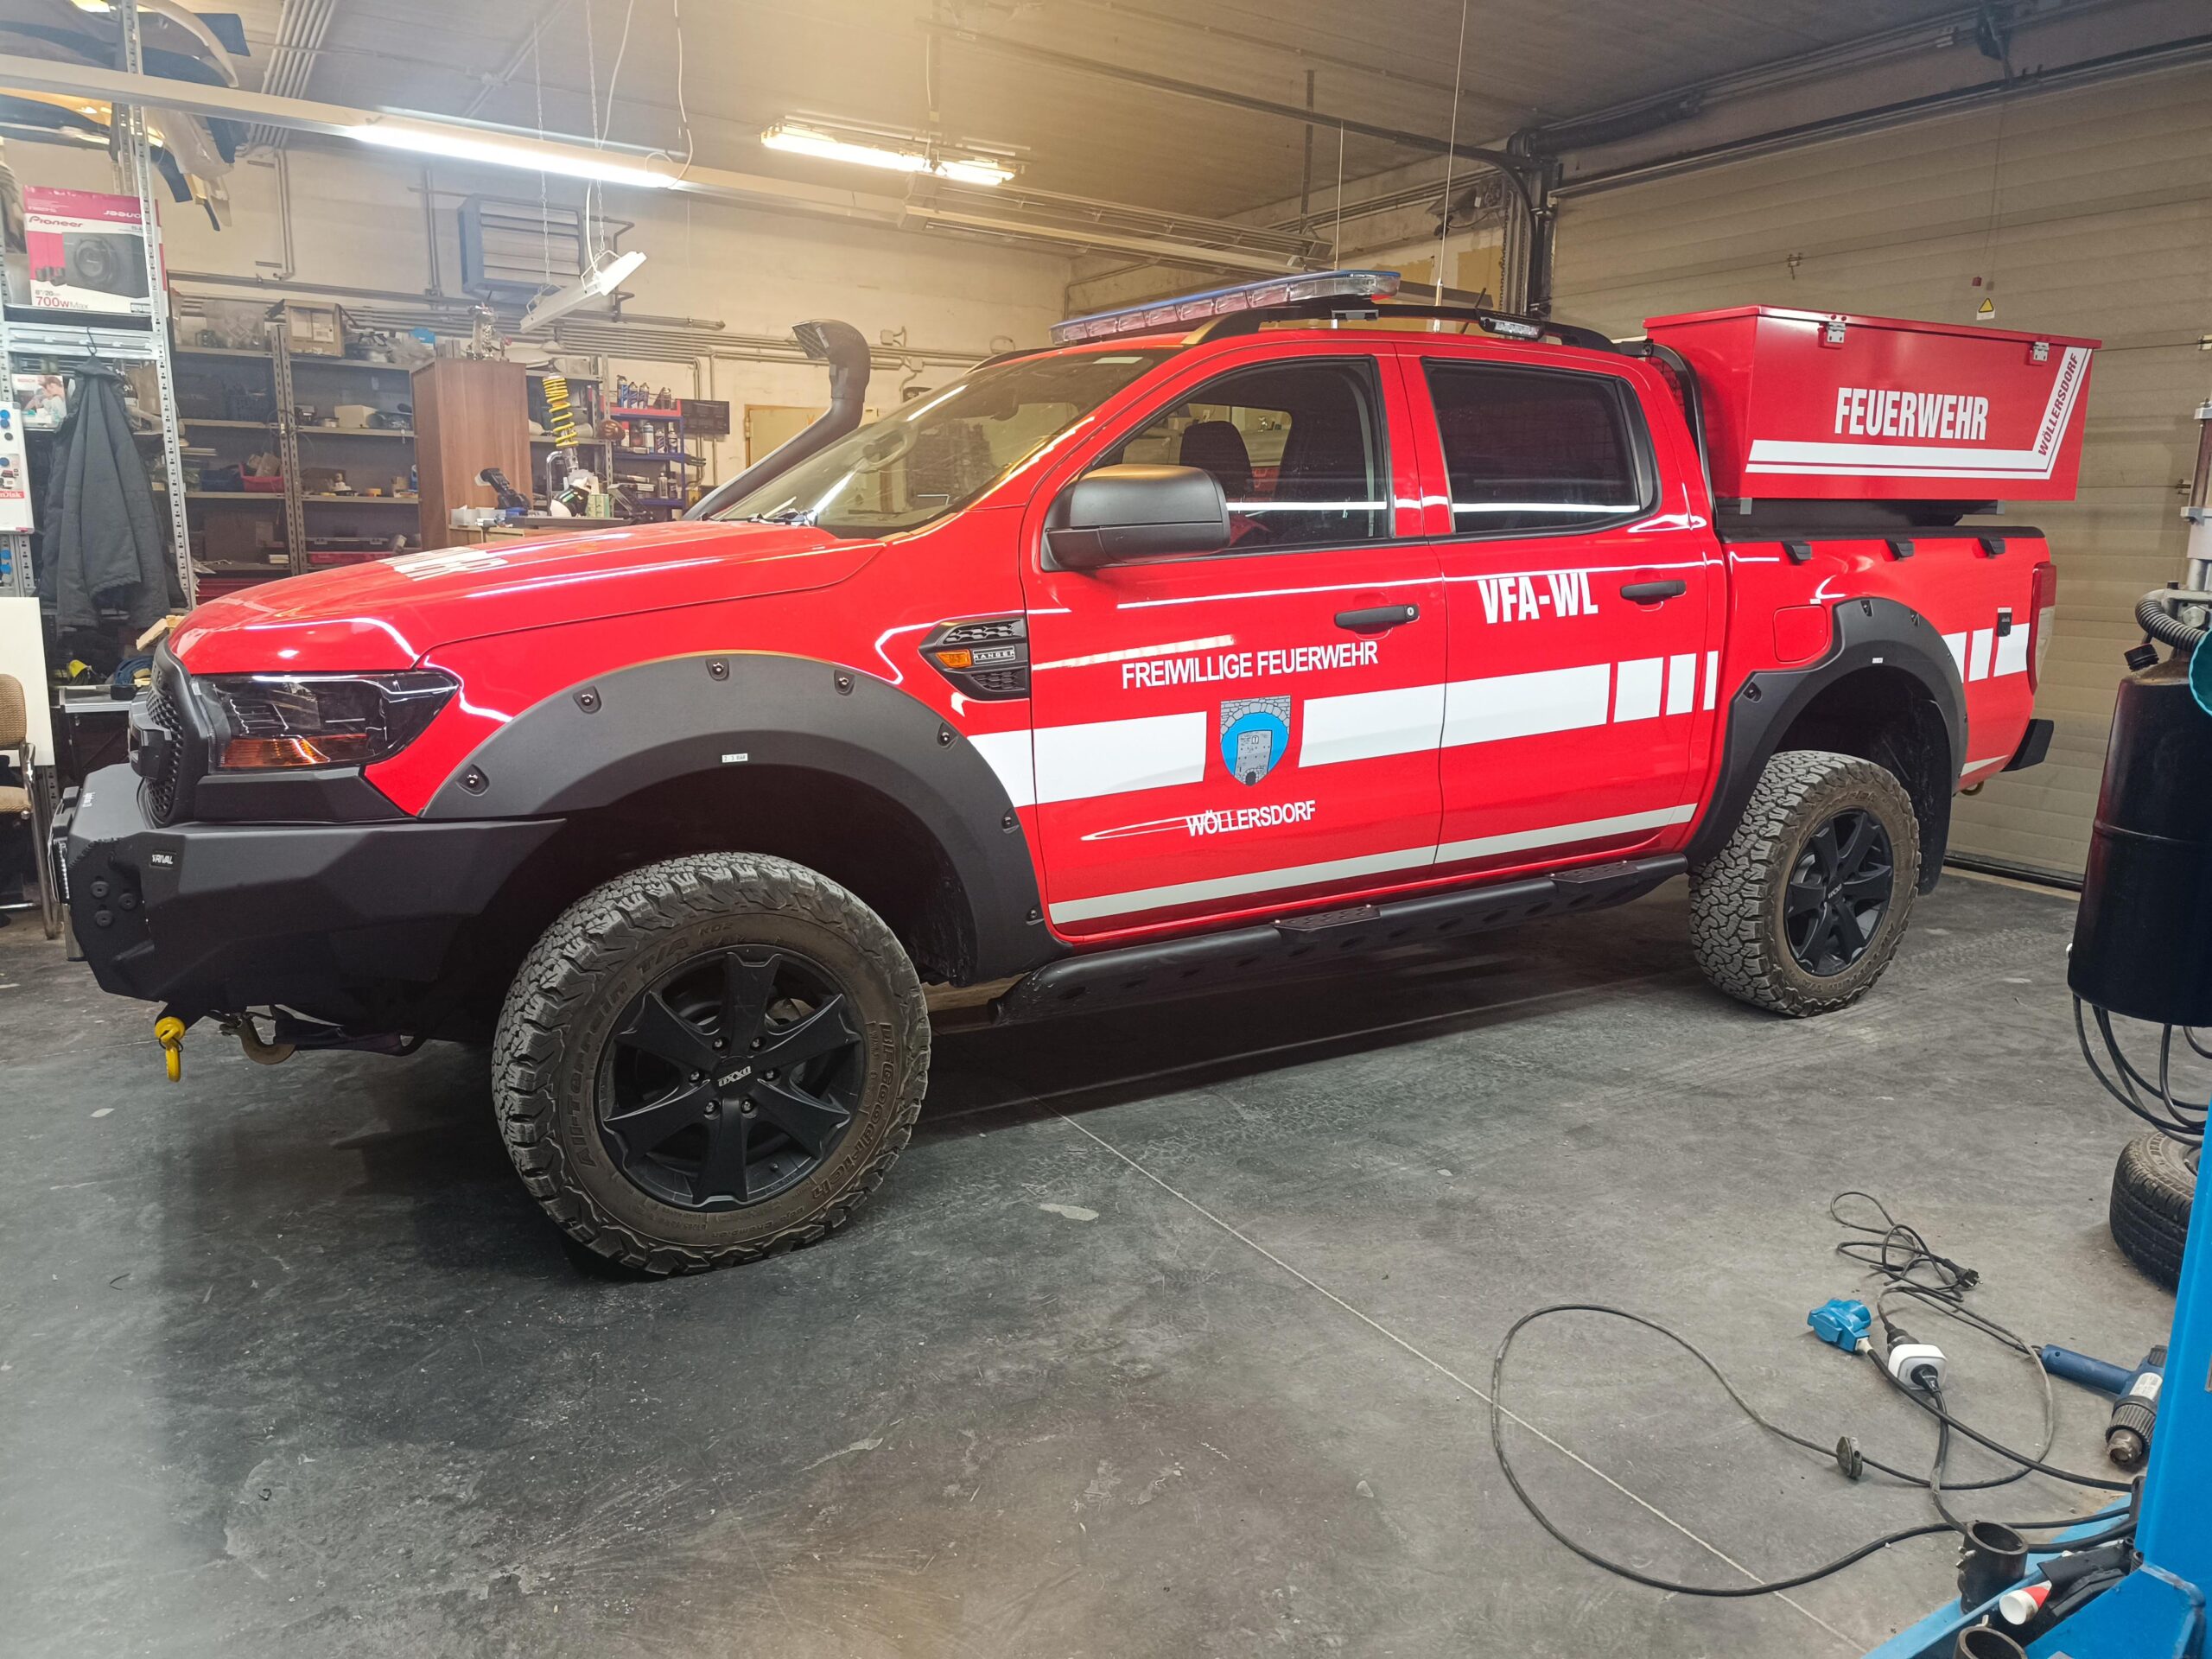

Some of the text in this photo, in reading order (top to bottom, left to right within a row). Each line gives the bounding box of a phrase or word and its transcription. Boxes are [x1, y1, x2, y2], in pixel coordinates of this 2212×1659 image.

[29, 215, 83, 228] Pioneer
[1834, 386, 1989, 441] FEUERWEHR
[2037, 353, 2077, 456] WÖLLERSDORF
[1477, 571, 1599, 624] VFA-WL
[1122, 640, 1378, 690] FREIWILLIGE FEUERWEHR
[1185, 799, 1316, 837] WÖLLERSDORF
